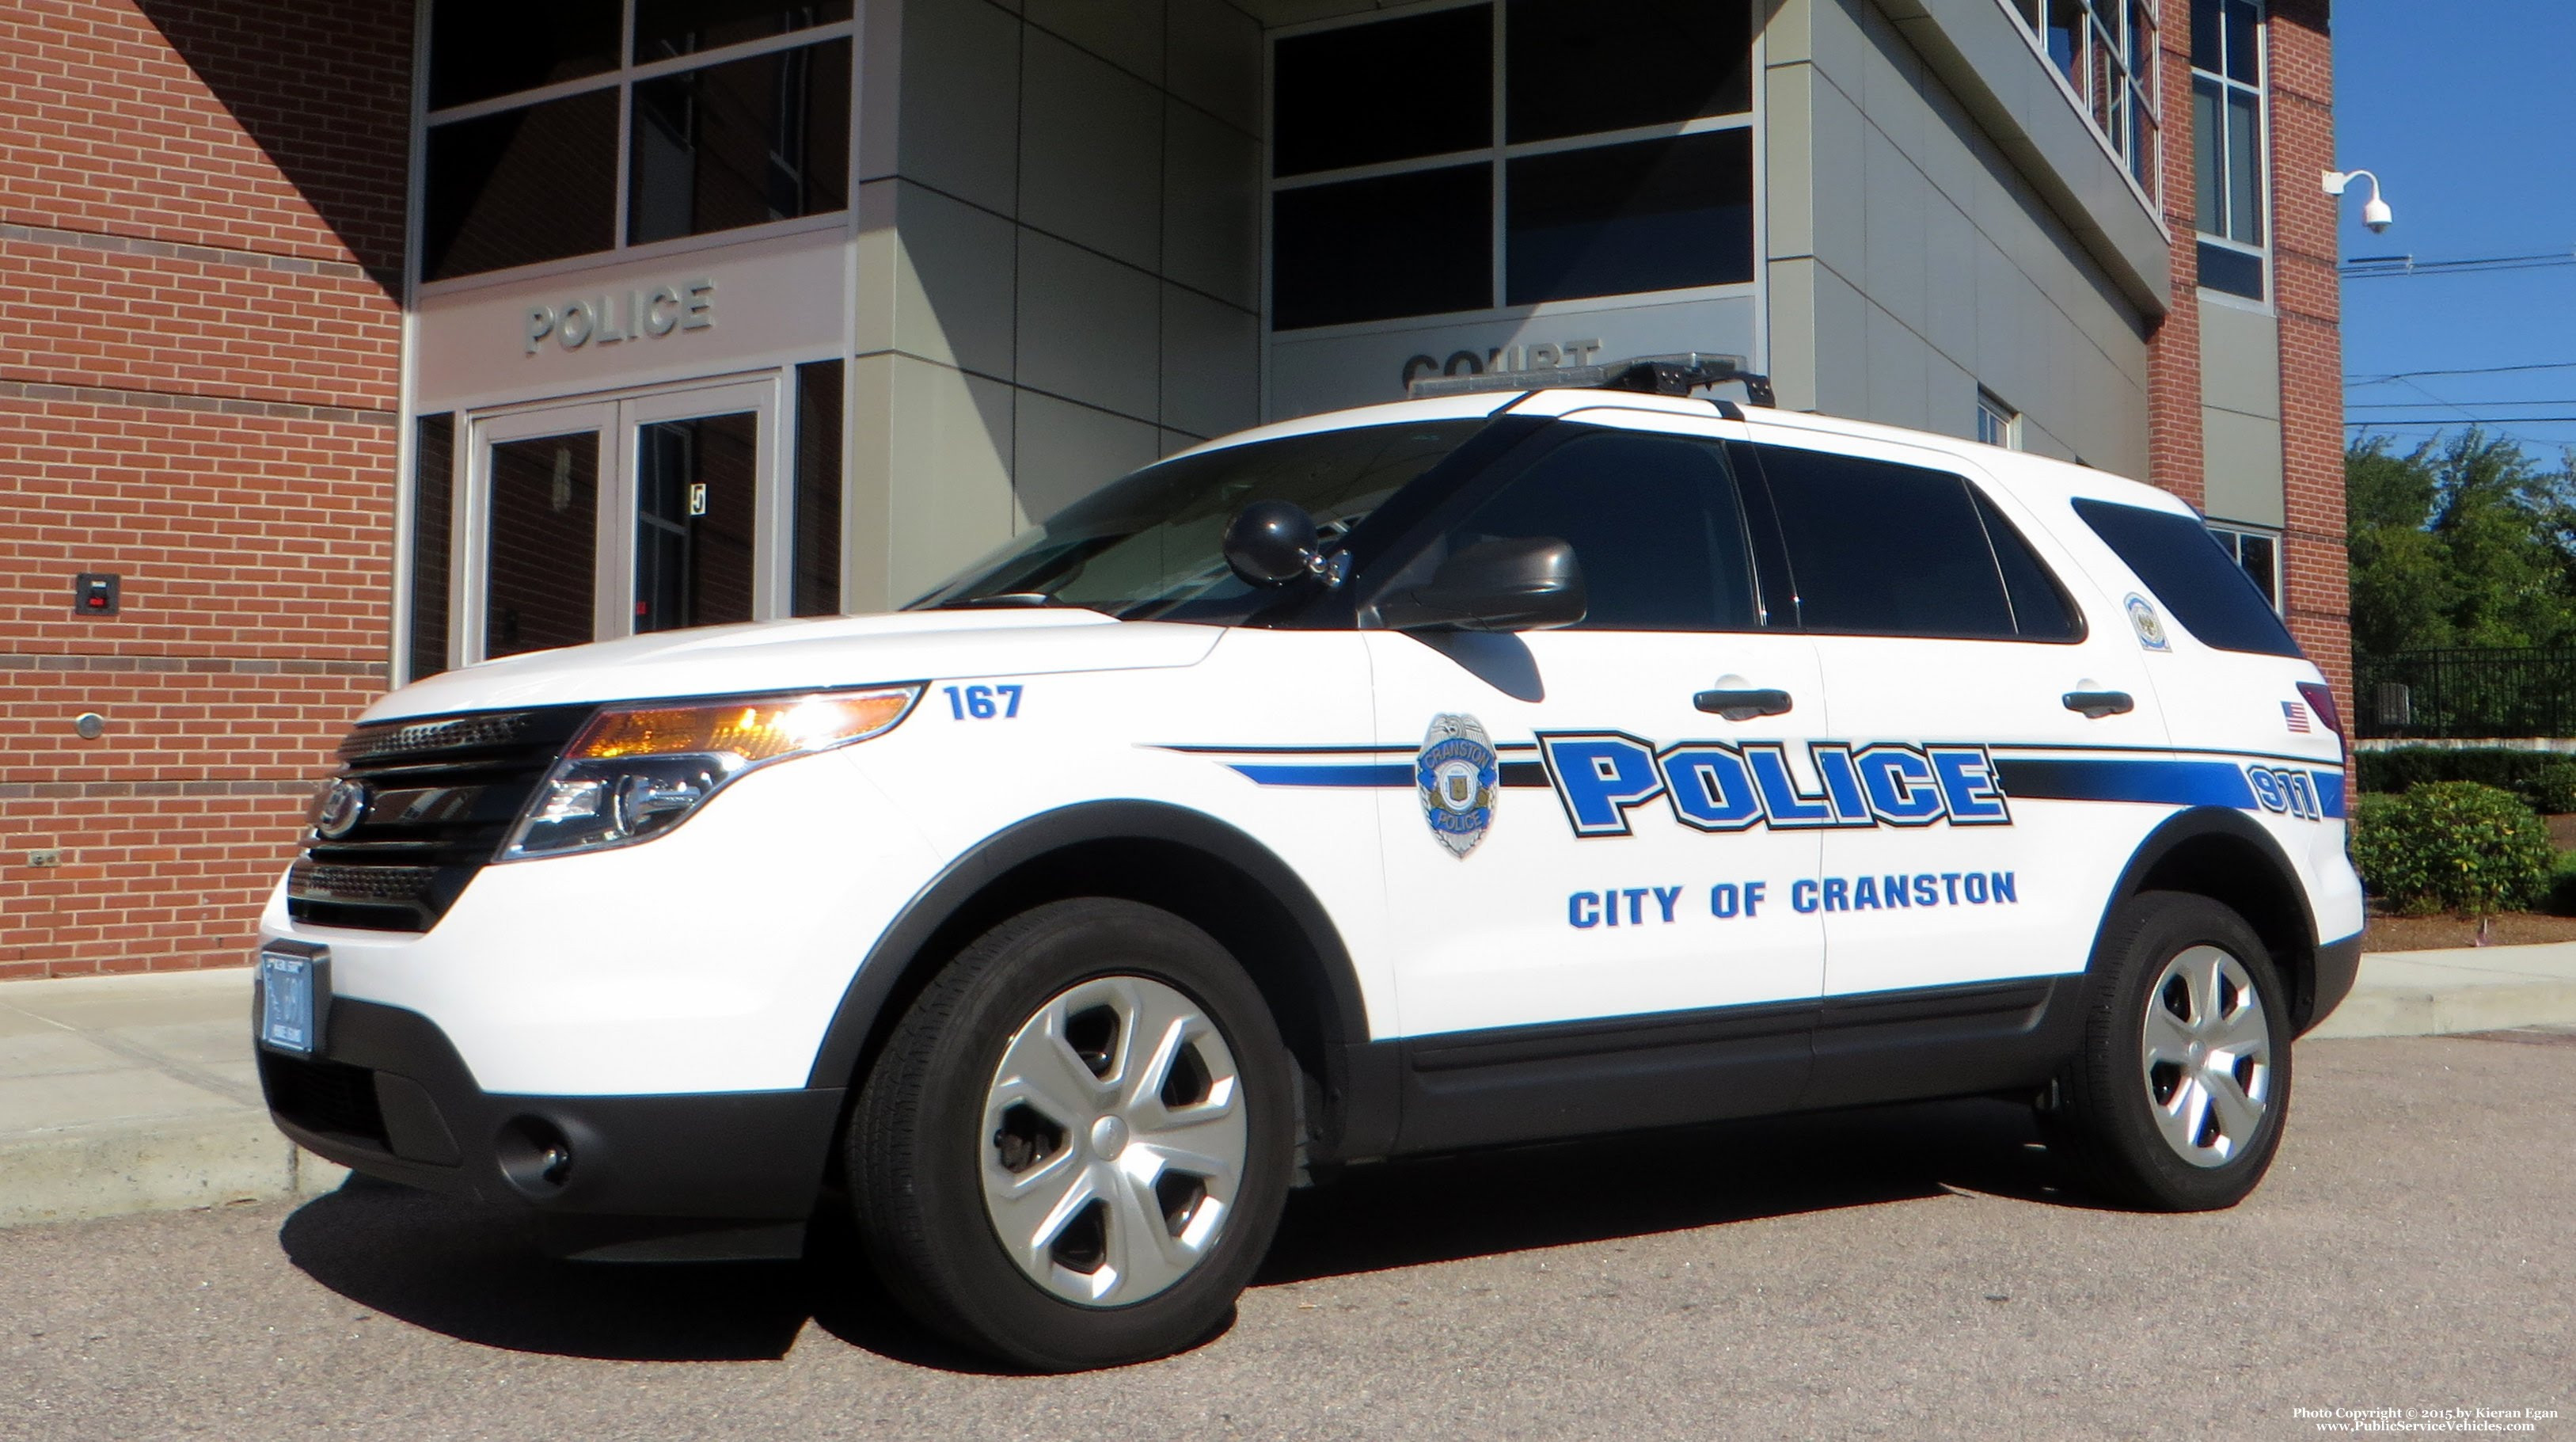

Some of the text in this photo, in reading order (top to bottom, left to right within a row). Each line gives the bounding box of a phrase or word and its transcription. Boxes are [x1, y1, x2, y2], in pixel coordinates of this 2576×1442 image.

[524, 276, 716, 356] POLICE
[691, 485, 705, 514] 5
[943, 685, 1024, 720] 167
[1426, 741, 1490, 769] CRANSTON
[1536, 730, 2012, 839] POLICE
[2247, 765, 2320, 821] 911
[1437, 812, 1483, 830] POLICE
[1569, 872, 2018, 929] CITY OF CRANSTON
